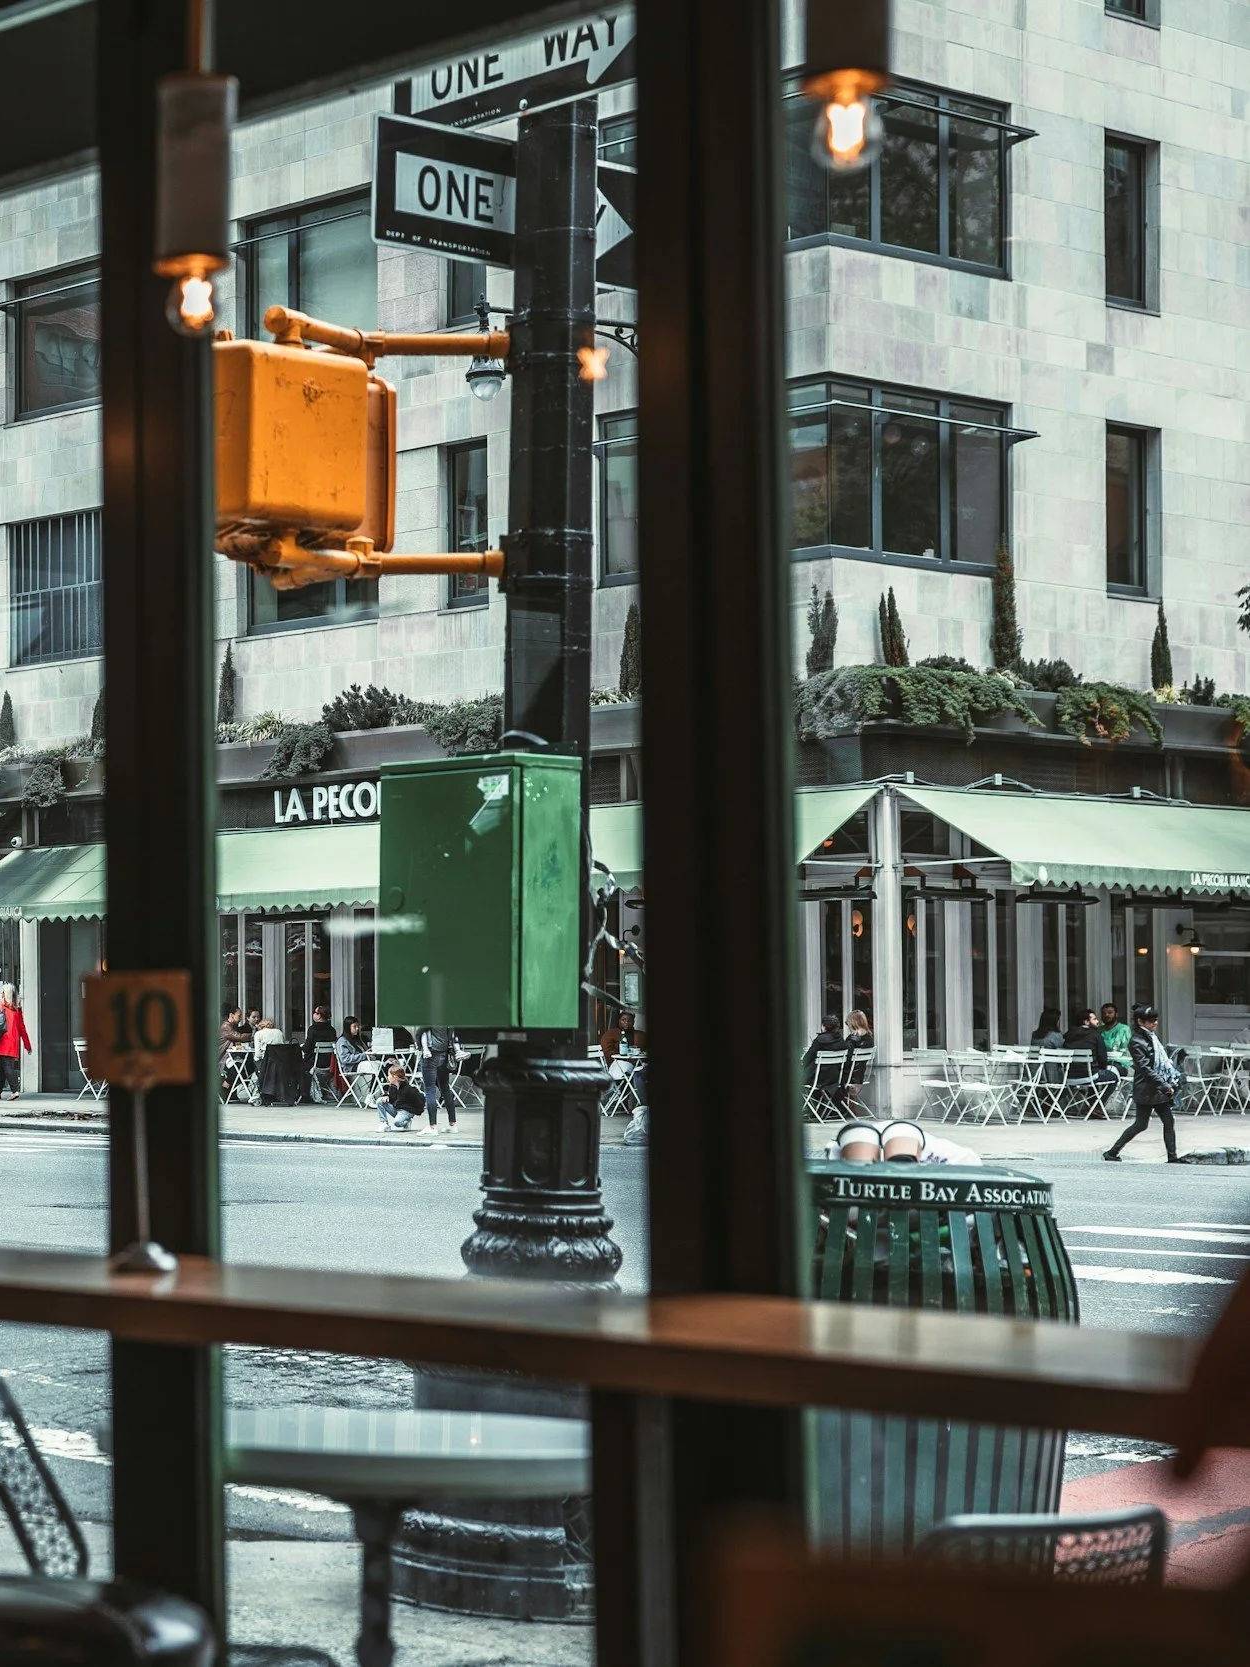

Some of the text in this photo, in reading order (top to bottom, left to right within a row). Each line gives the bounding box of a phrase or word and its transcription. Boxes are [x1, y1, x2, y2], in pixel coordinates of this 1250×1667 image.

[431, 15, 618, 100] ONE WAY
[418, 164, 494, 224] ONE
[274, 781, 381, 823] LA PECO
[1190, 872, 1250, 888] LA PECORA BIANC
[111, 989, 178, 1055] 10
[834, 1176, 1053, 1205] TURTLE BAY ASSOCIATION
